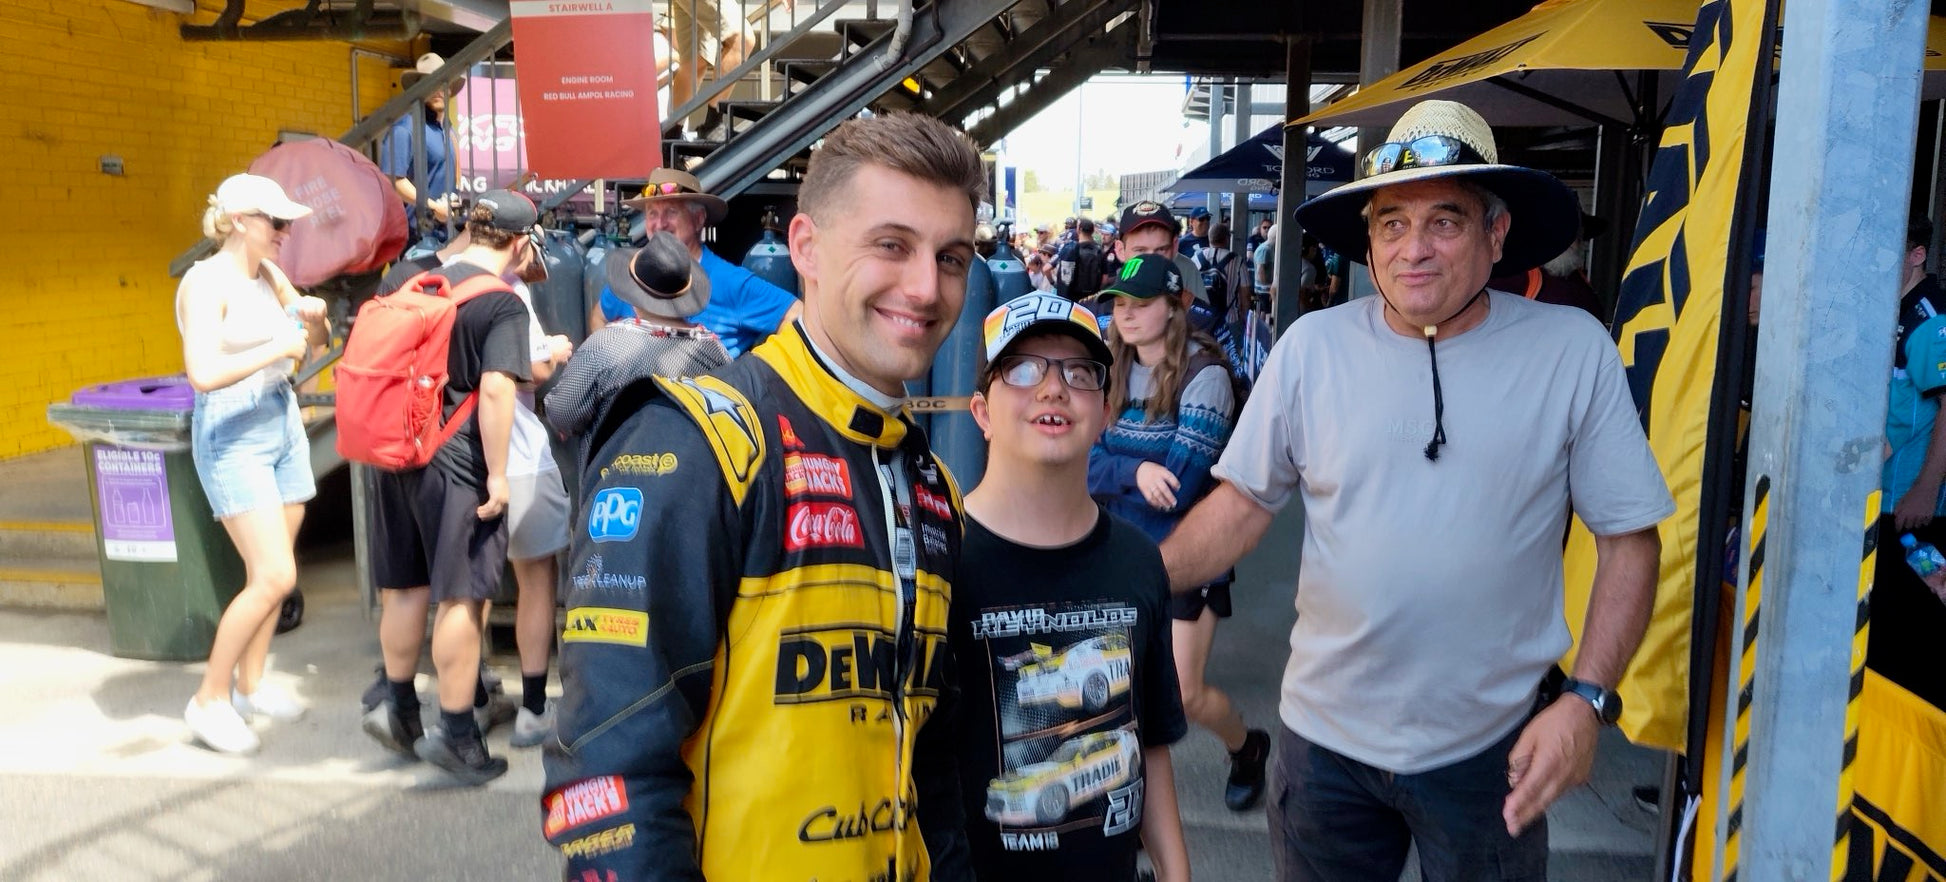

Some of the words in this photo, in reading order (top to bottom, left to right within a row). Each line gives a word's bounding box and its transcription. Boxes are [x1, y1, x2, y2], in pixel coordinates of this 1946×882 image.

[549, 3, 603, 12] STAIRWELL
[604, 3, 613, 11] A
[561, 75, 588, 84] ENGINE
[590, 75, 613, 83] ROOM
[543, 92, 558, 100] RED
[559, 91, 576, 100] BULL
[578, 91, 603, 99] AMPOL
[605, 90, 634, 98] RACING
[1003, 294, 1074, 332] 20
[97, 449, 140, 463] ELIGIBLE
[802, 456, 840, 474] HUNGRY
[98, 462, 163, 474] CONTAINERS
[592, 493, 638, 534] PPG
[970, 607, 1138, 640] REYNOLDS
[981, 608, 1045, 623] DAVID
[1073, 755, 1122, 793] TRADIE
[564, 775, 616, 802] HUNGRY
[798, 802, 868, 842] Cub
